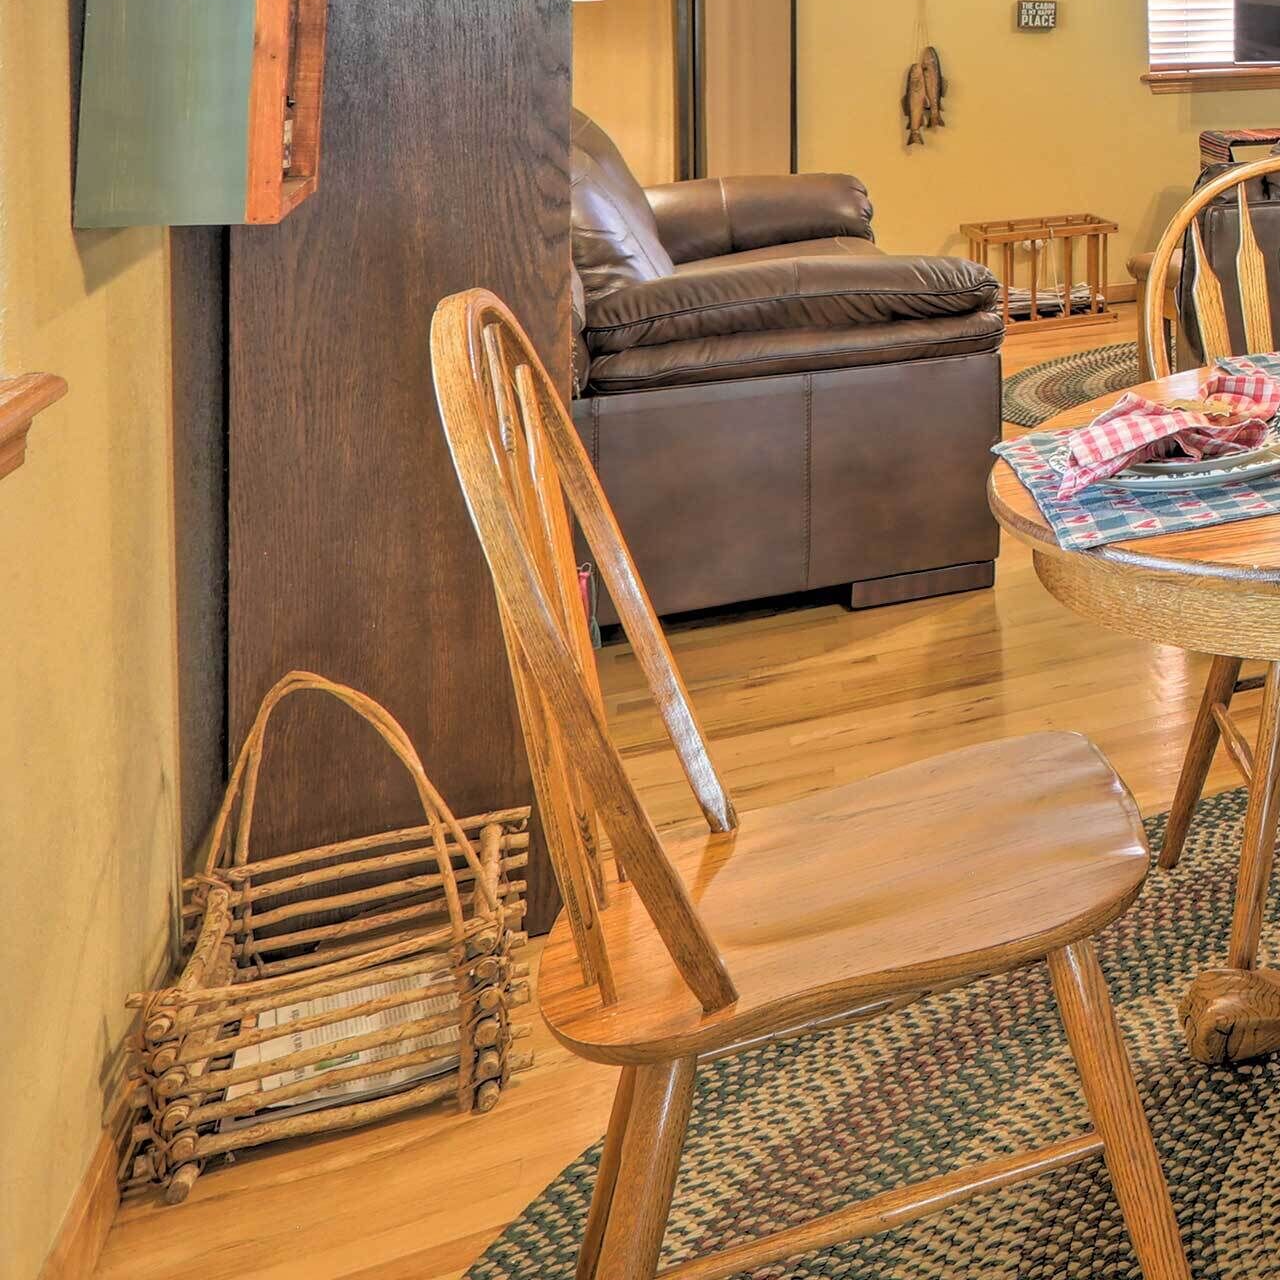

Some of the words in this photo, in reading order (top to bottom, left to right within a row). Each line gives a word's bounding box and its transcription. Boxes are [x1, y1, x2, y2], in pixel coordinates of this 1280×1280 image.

[1022, 1, 1034, 9] THE
[1034, 2, 1056, 10] CABIN
[1021, 15, 1056, 27] PLACE
